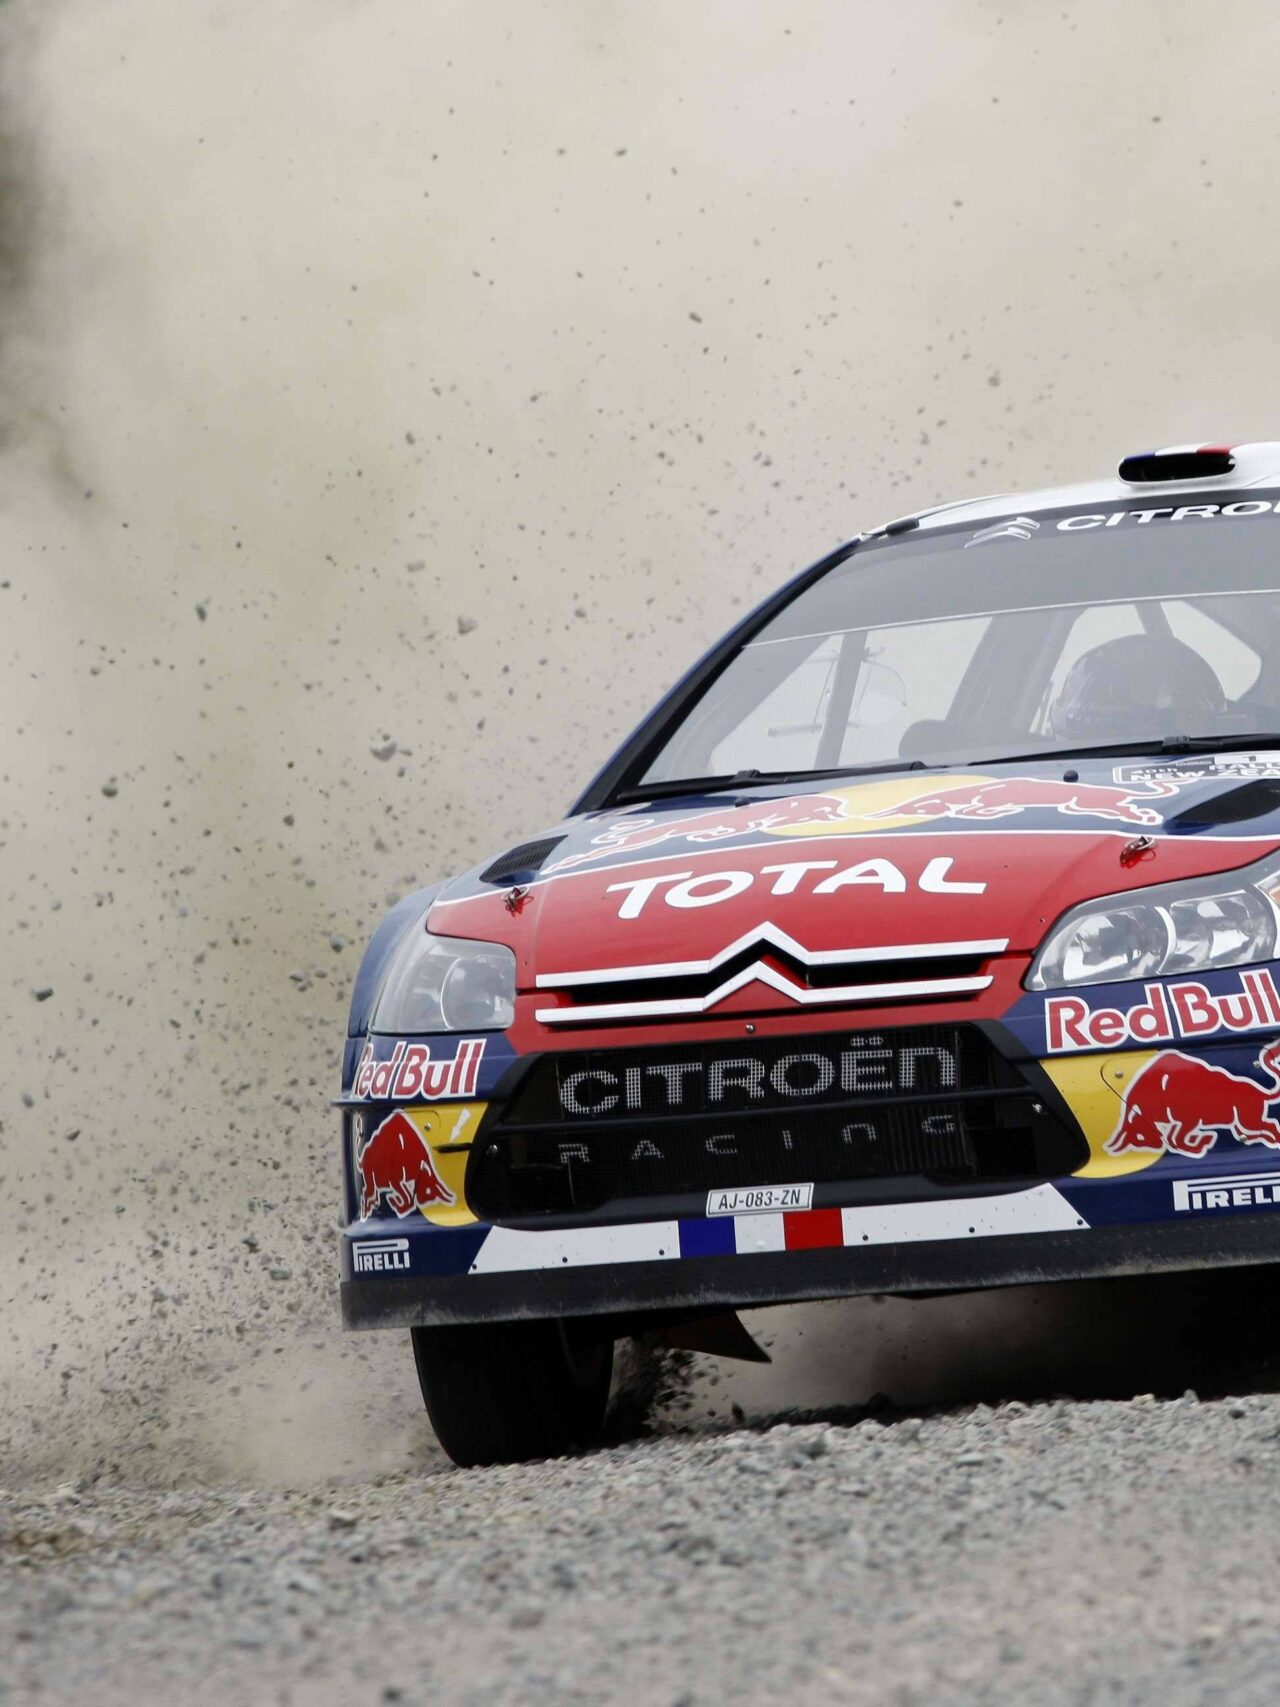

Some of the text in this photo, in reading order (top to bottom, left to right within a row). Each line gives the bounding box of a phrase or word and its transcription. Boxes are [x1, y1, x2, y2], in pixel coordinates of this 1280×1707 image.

[606, 857, 987, 919] TOTAL
[1044, 983, 1174, 1053] Red
[391, 1038, 487, 1100] Bull
[718, 1188, 801, 1211] AJ-083-ZN
[352, 1238, 410, 1272] PIRELLI
